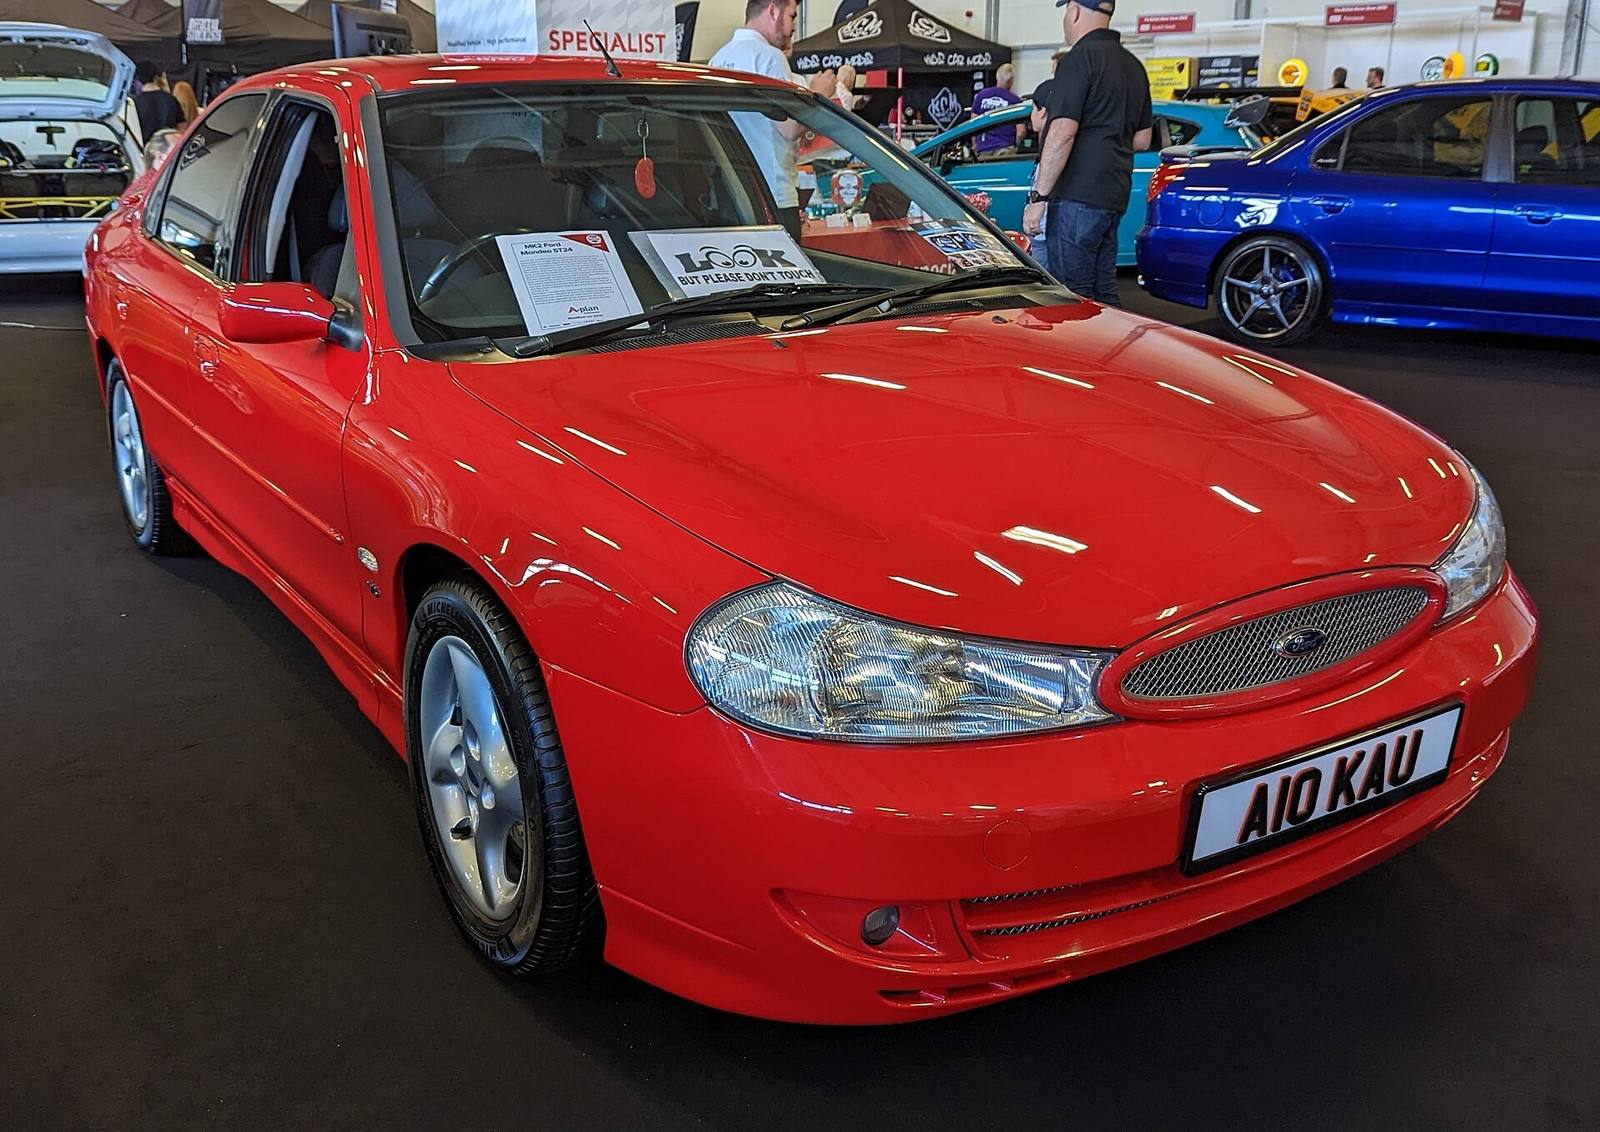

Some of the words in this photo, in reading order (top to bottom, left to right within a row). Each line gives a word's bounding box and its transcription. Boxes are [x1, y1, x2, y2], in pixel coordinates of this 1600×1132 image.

[549, 29, 667, 54] SPECIALIST
[931, 92, 959, 114] KCM
[520, 248, 552, 256] Mondeo
[552, 246, 574, 254] ST24
[675, 245, 797, 273] LOOK
[678, 274, 702, 286] BUT
[704, 272, 746, 285] PLEASE
[744, 271, 775, 282] DON'T
[779, 269, 815, 280] TOUCH
[1325, 728, 1425, 812] KAU
